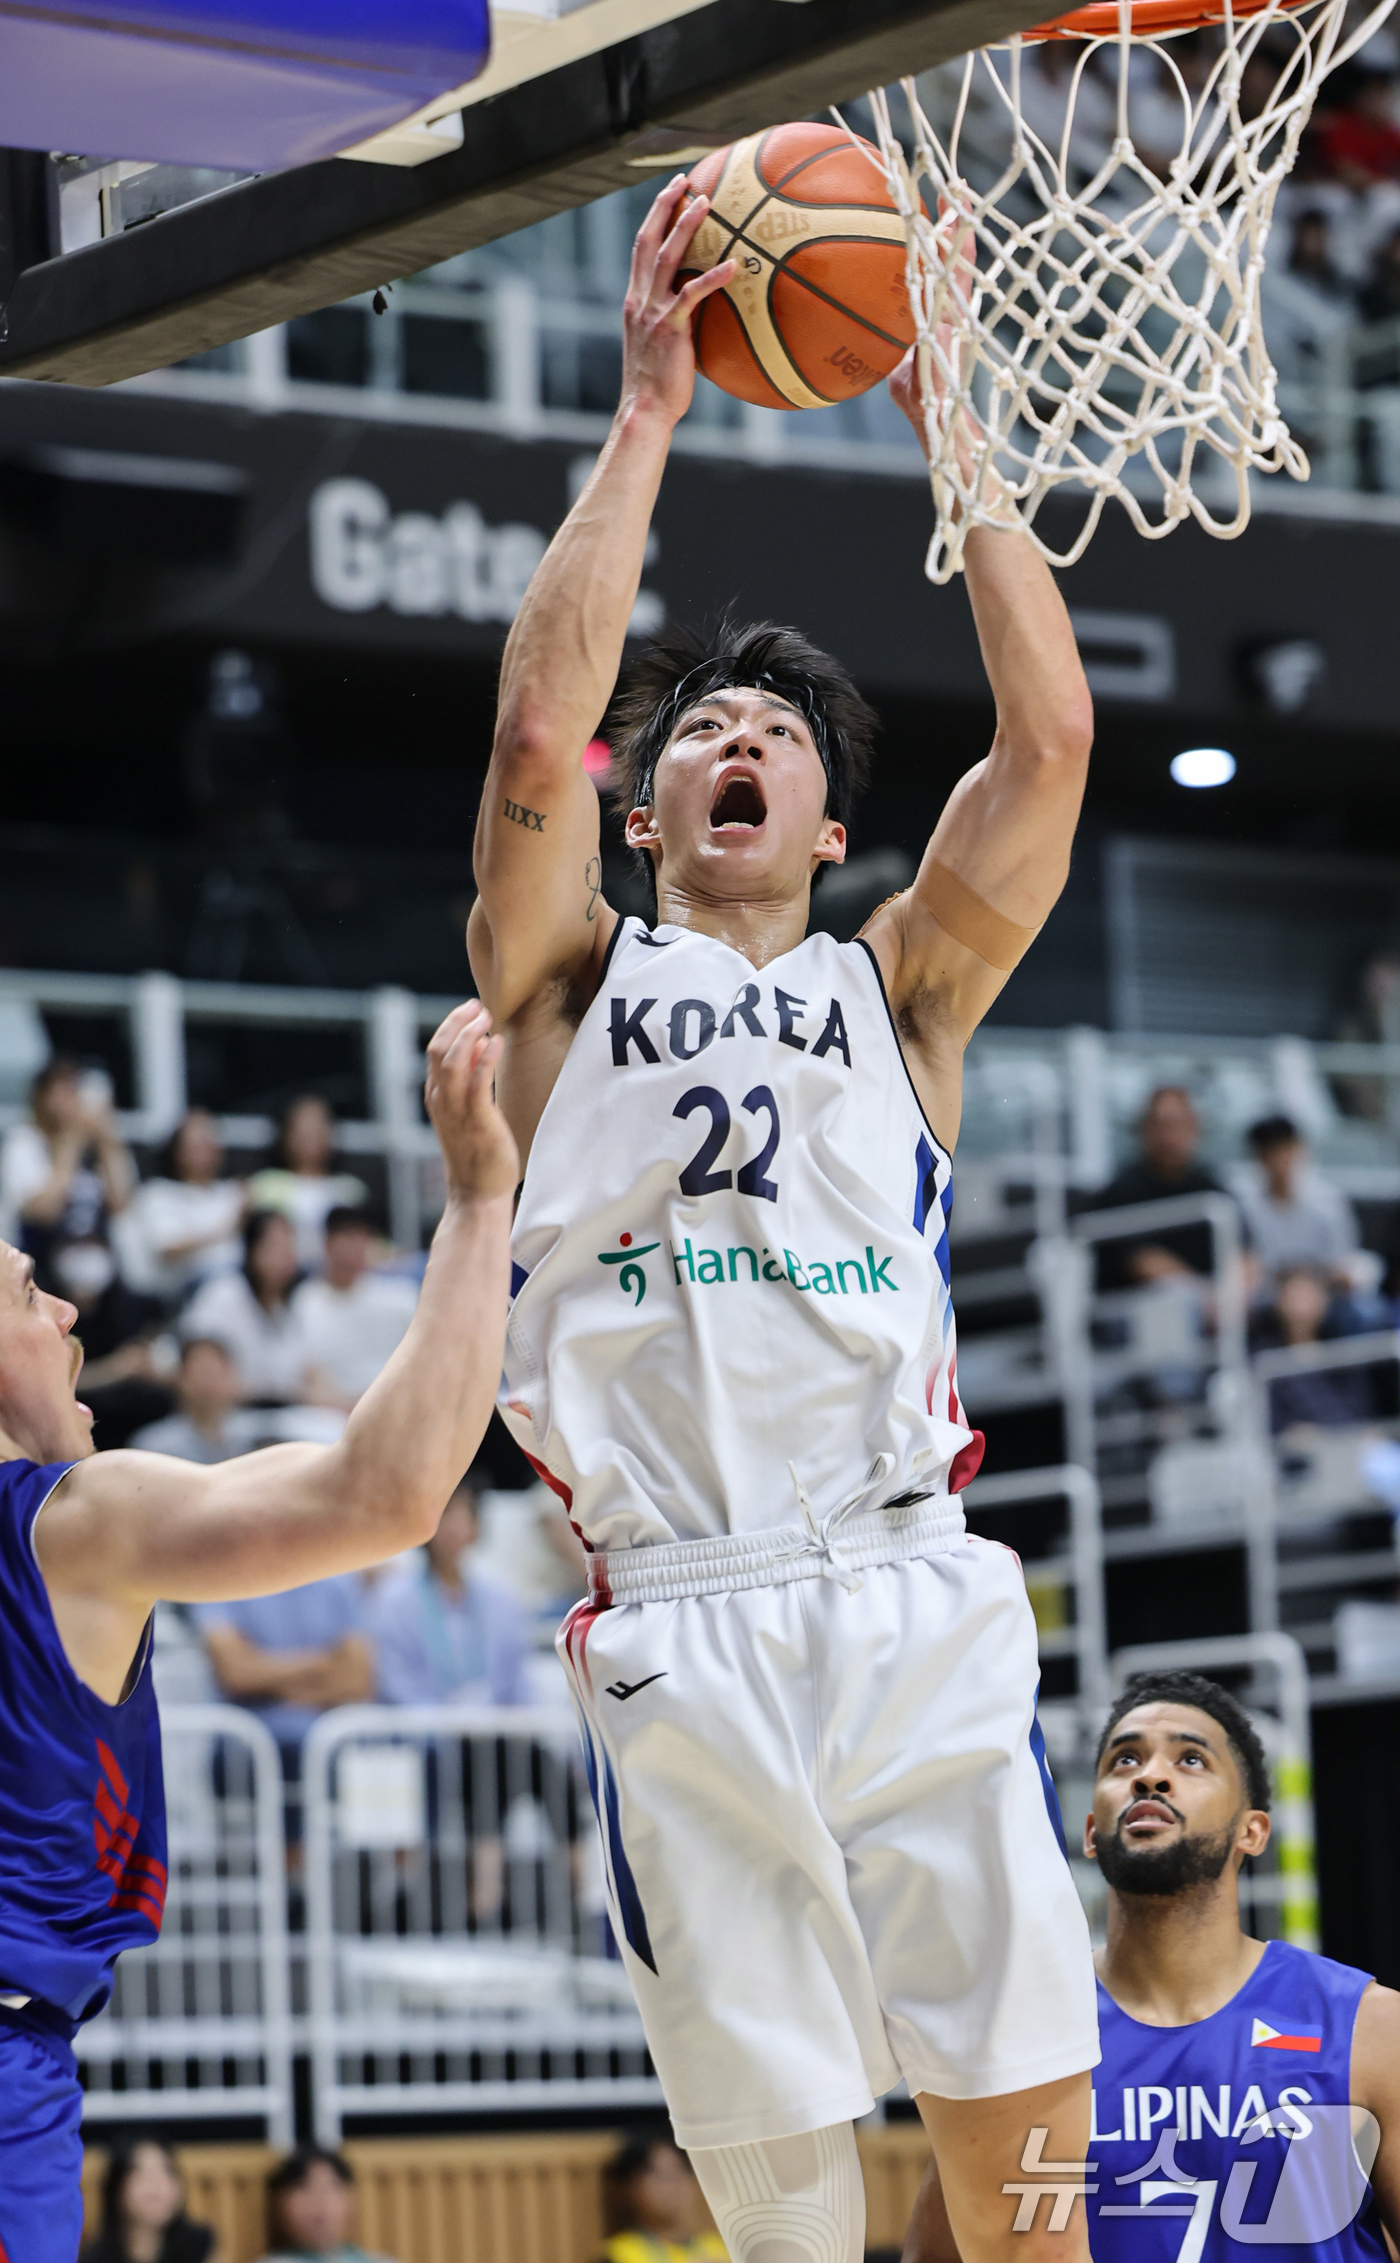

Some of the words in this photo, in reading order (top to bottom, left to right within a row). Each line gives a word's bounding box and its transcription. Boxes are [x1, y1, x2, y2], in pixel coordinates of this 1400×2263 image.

[607, 983, 852, 1070] KOREA
[672, 1085, 780, 1203] 22
[1140, 2180, 1218, 2263] 7
